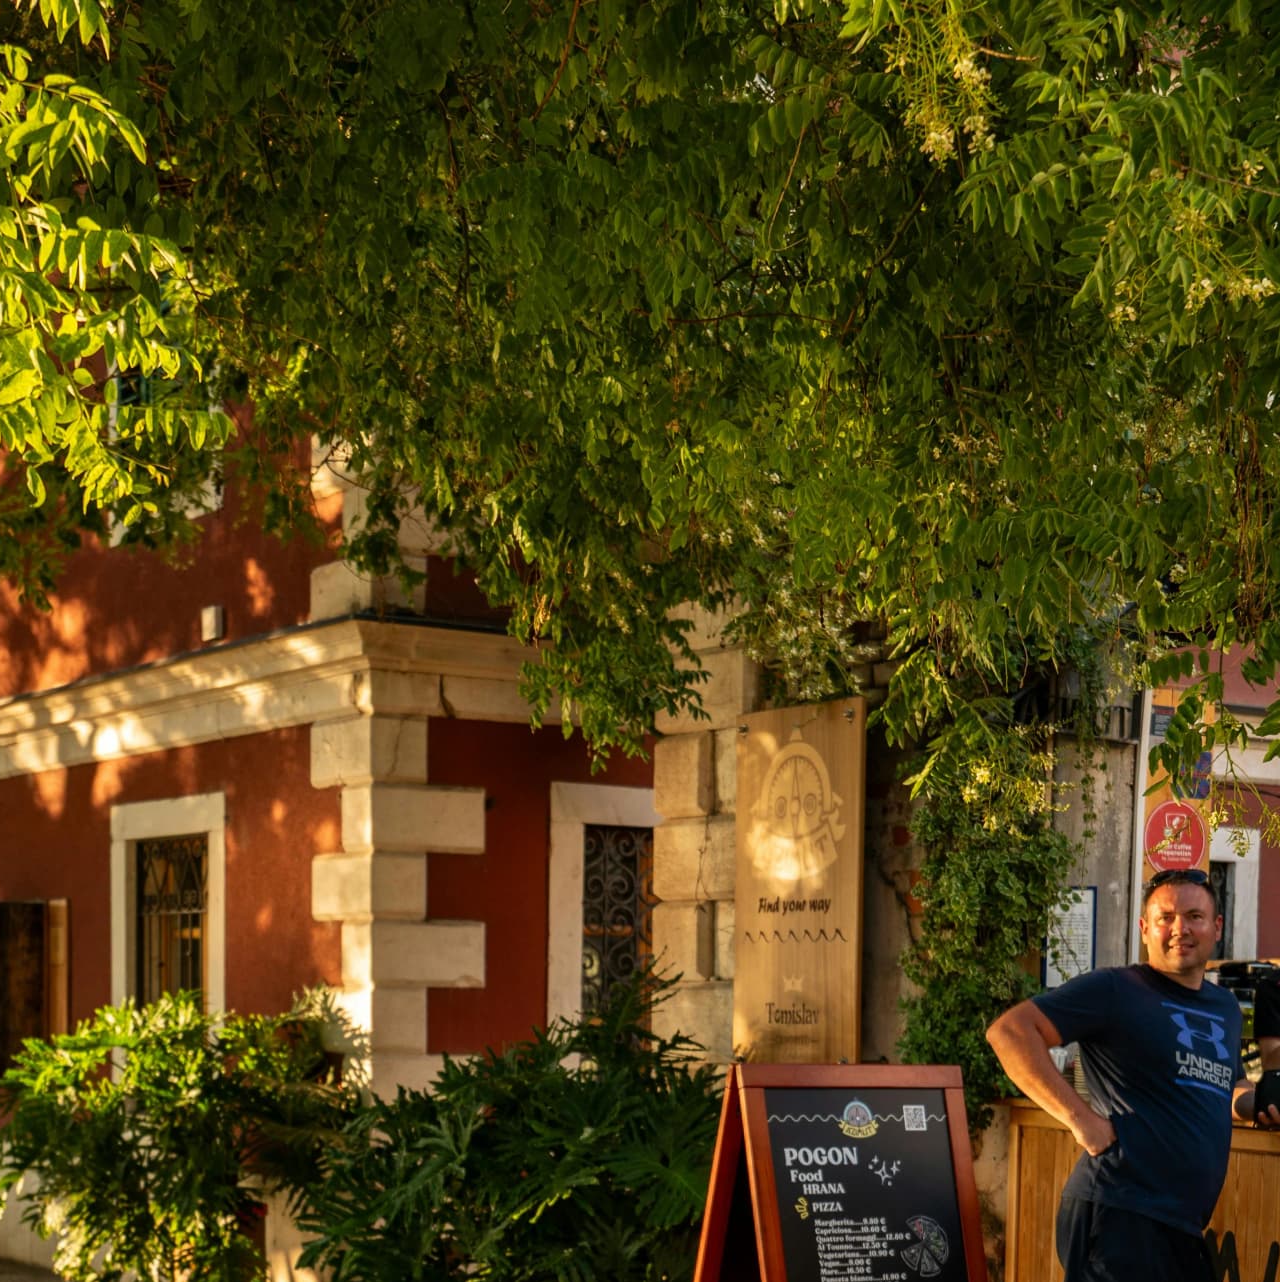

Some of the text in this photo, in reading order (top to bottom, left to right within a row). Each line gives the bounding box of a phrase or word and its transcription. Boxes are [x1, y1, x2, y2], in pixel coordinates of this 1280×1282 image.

[758, 896, 832, 916] Find your way
[1176, 1050, 1232, 1081] UNDER
[1178, 1065, 1231, 1091] ARMOUR
[784, 1146, 858, 1166] POGON
[790, 1169, 823, 1182] Food
[803, 1183, 846, 1195] HRANA
[812, 1201, 843, 1212] PIZZA
[814, 1218, 854, 1227] Margherita
[815, 1235, 844, 1244] Quattro
